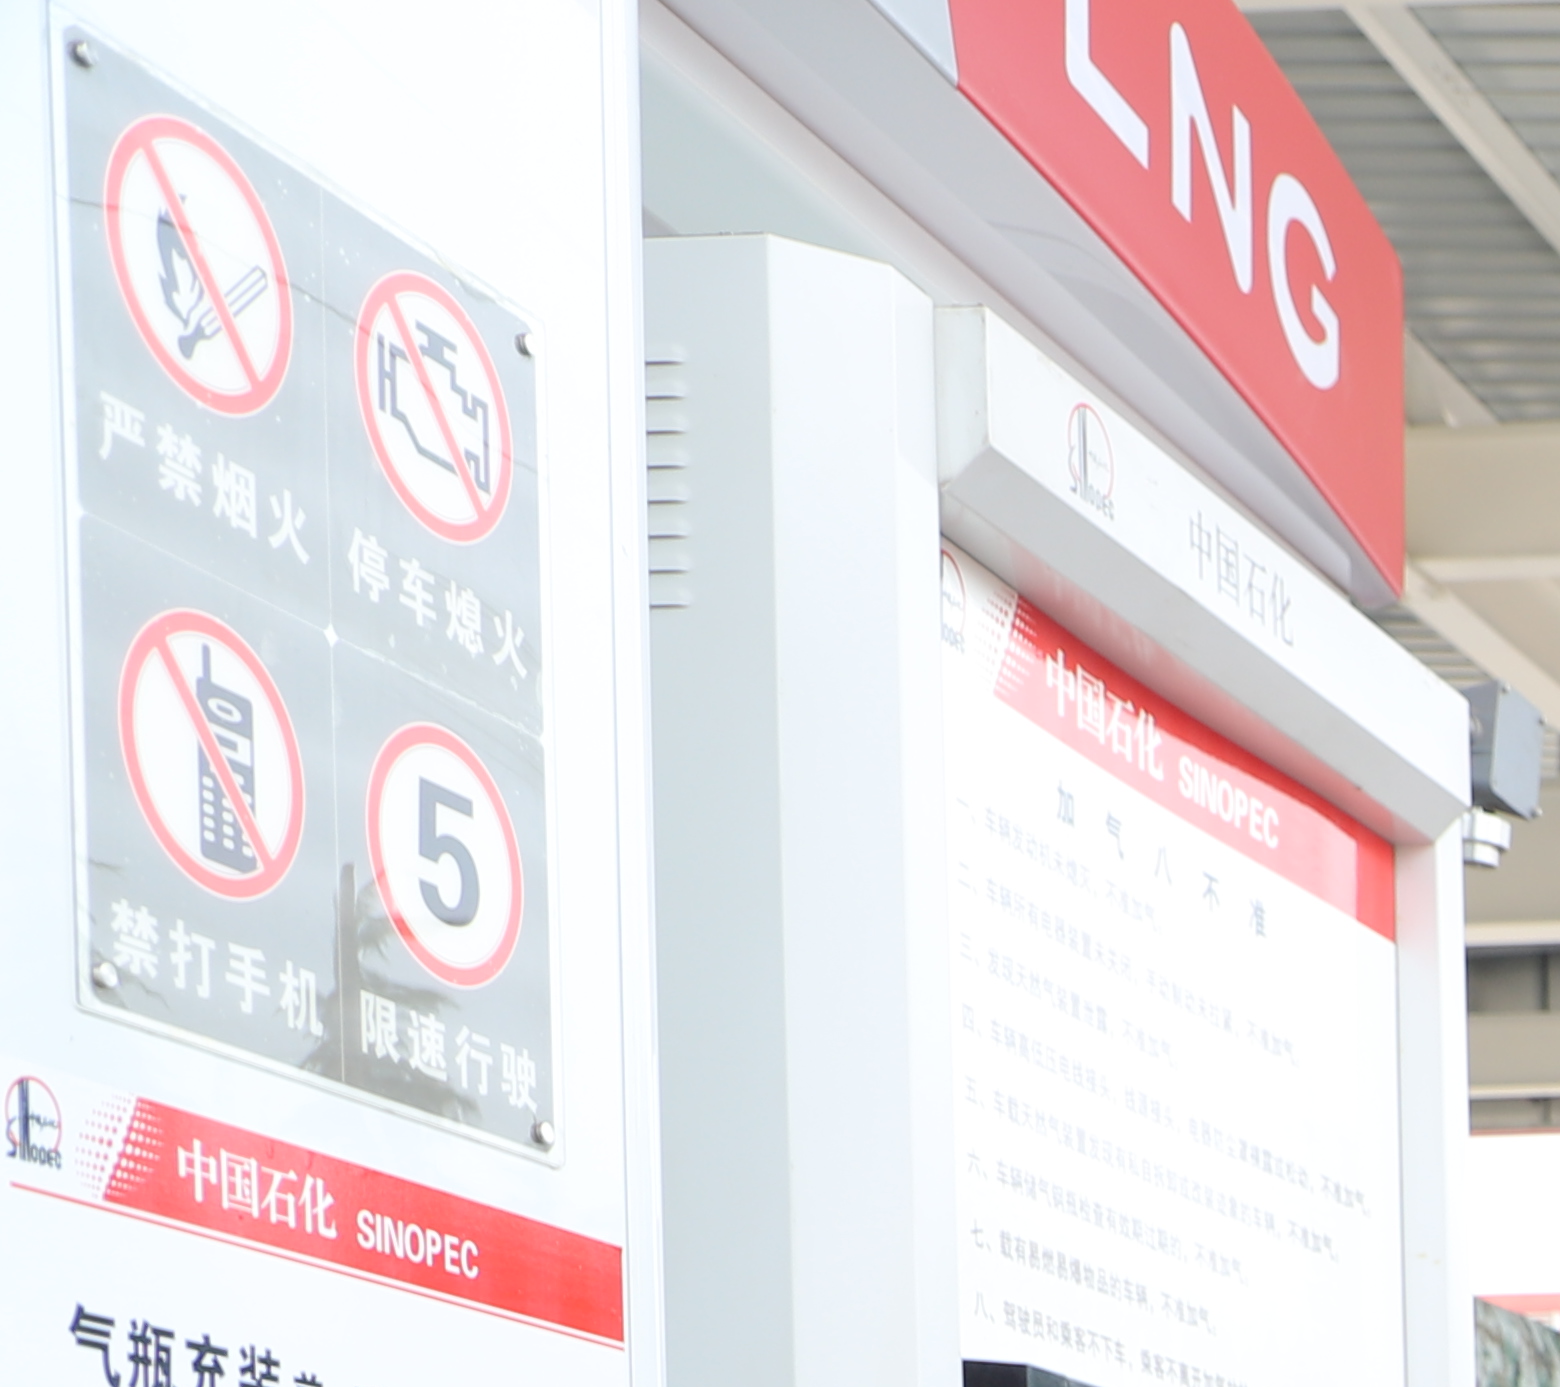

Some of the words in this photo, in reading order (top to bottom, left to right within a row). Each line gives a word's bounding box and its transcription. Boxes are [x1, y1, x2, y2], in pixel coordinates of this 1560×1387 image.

[1065, 0, 1339, 389] LNG
[98, 389, 310, 565] 严禁烟火
[347, 526, 533, 682] 停车熄火
[1190, 510, 1294, 647] 中国石化
[1045, 647, 1164, 780] 中国石化
[1178, 755, 1279, 849] SINOPEC
[417, 776, 482, 930] 5
[1056, 782, 1266, 938] 加气八不准
[109, 898, 324, 1039] 禁打手机
[359, 990, 539, 1114] 限速行驶
[177, 1138, 337, 1240] 中国石化
[356, 1208, 480, 1280] SINOPEC
